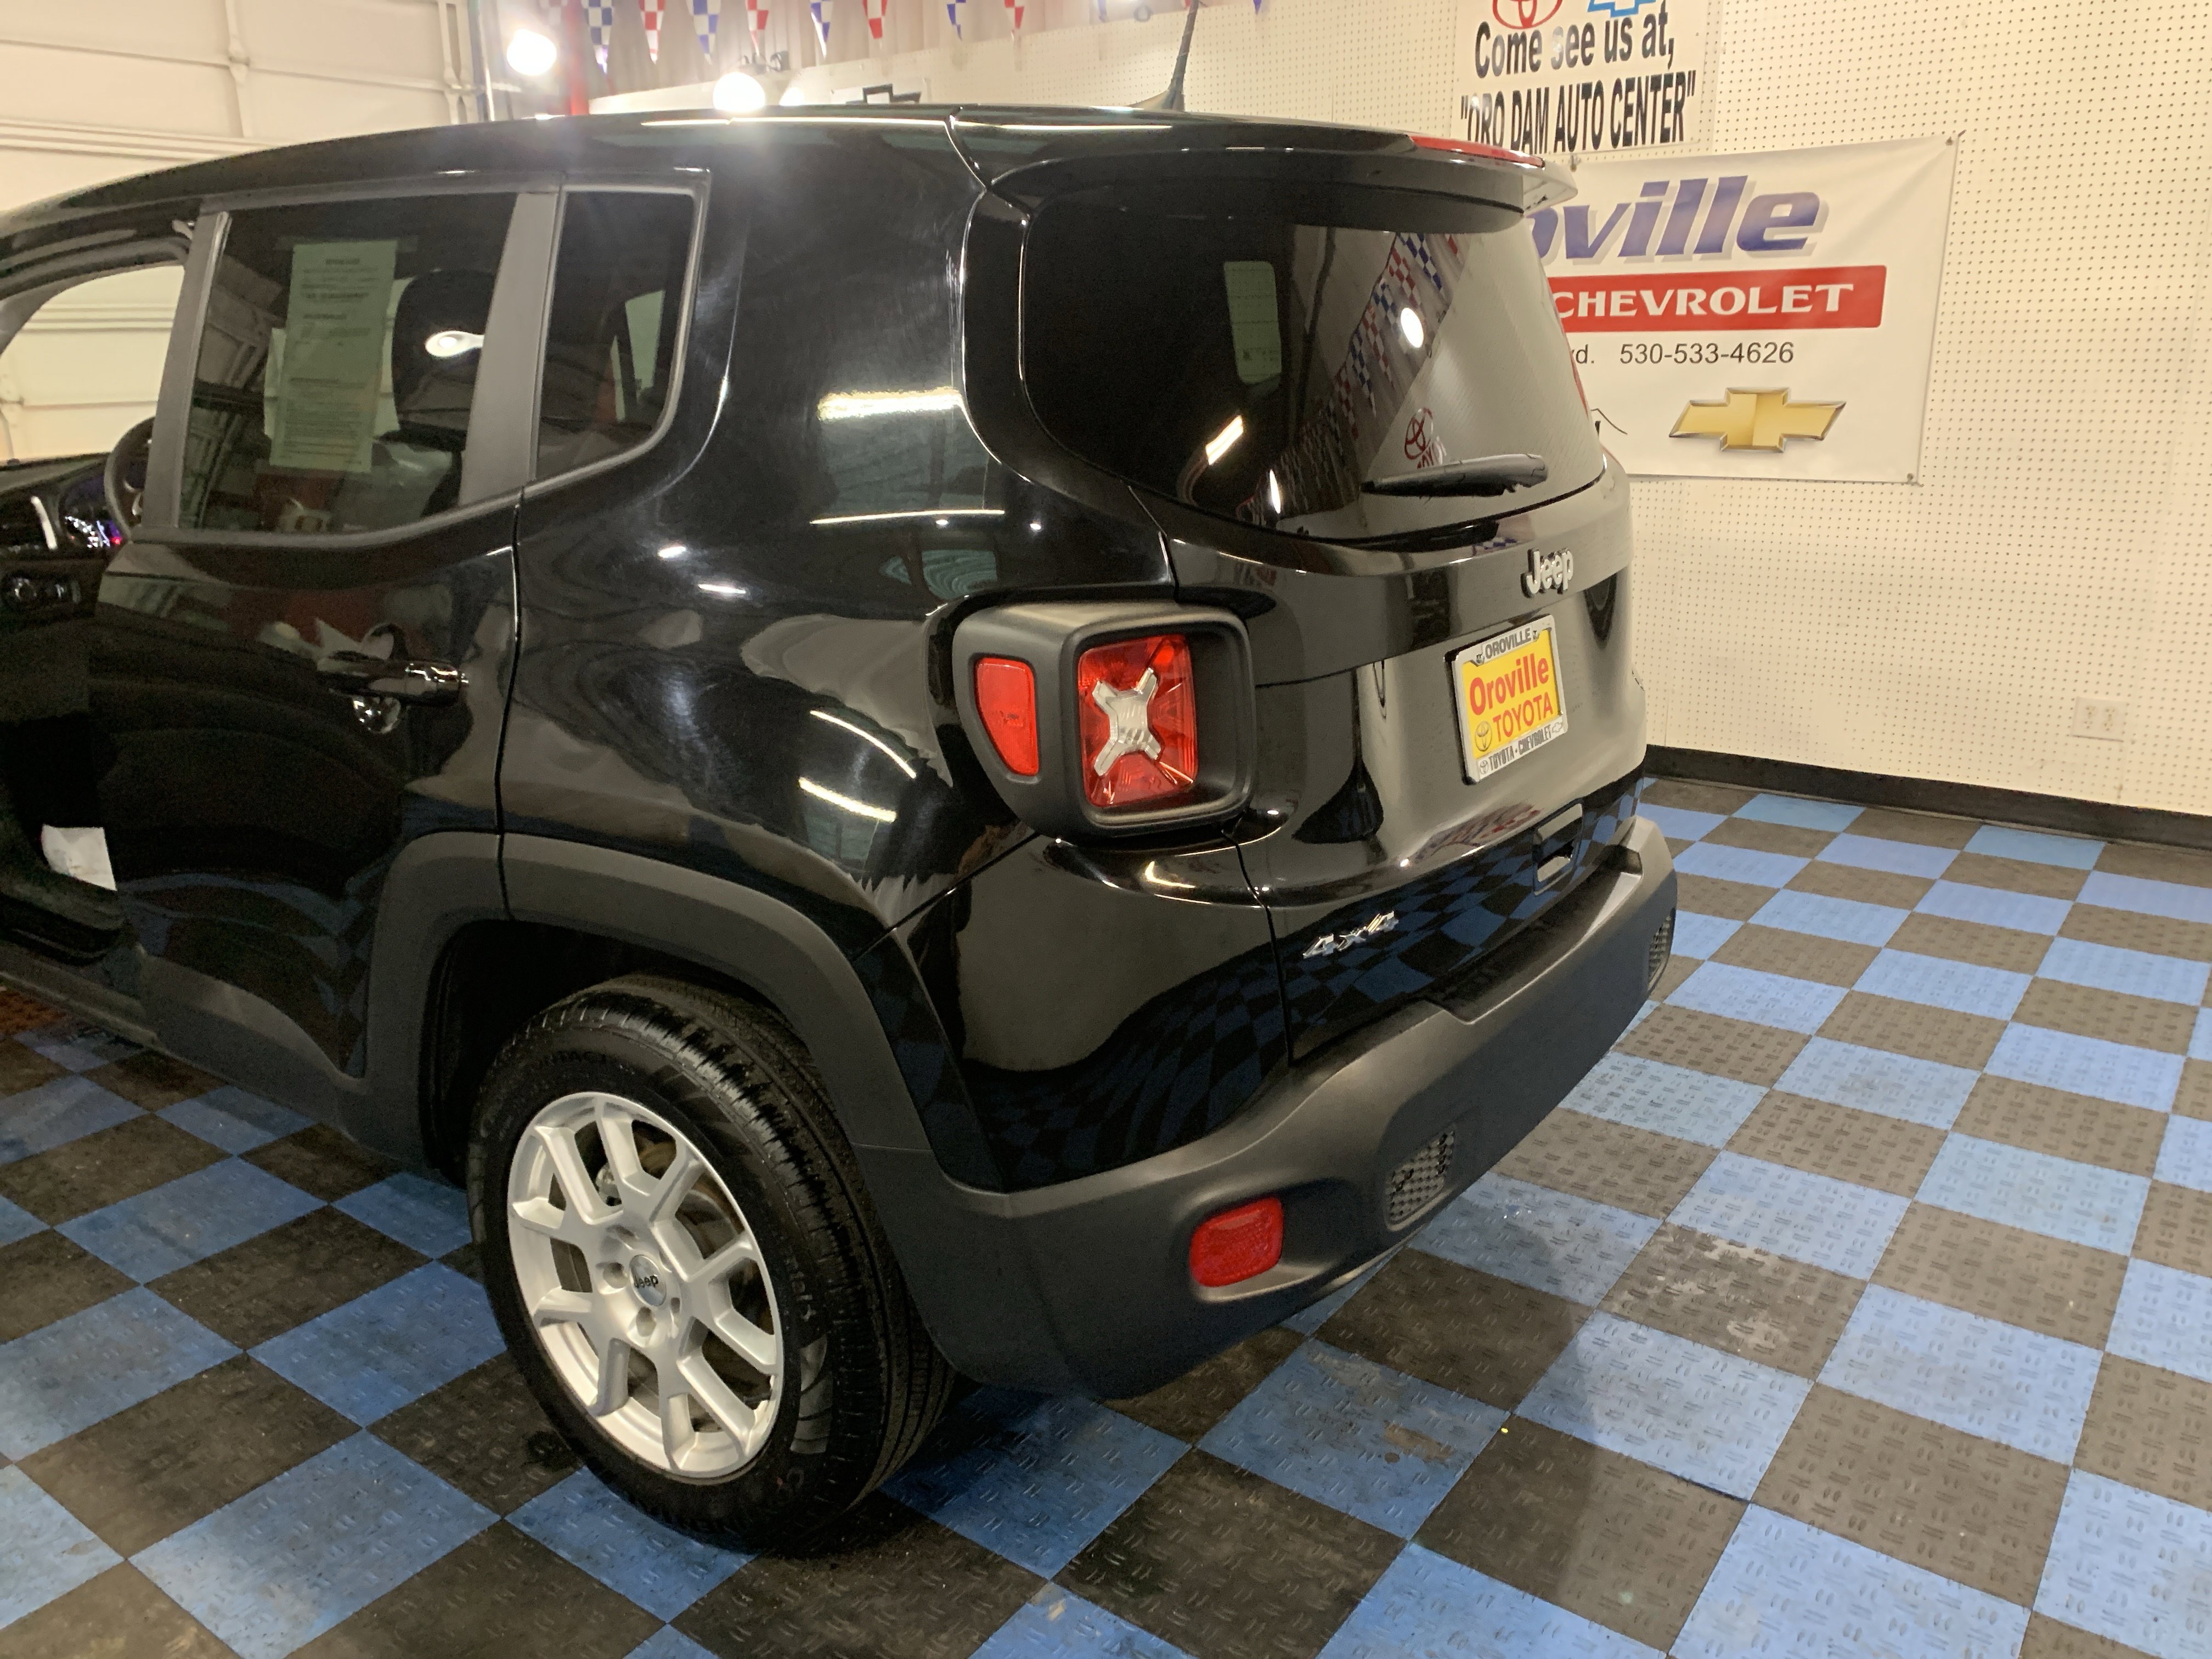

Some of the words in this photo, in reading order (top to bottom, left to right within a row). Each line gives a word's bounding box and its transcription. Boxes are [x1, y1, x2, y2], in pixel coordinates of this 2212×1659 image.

[1475, 21, 1543, 78] Come
[1550, 21, 1595, 70] see
[1604, 17, 1633, 63] us
[1641, 0, 1674, 70] at,
[1510, 86, 1550, 154] DAM
[1554, 80, 1604, 153] AUTO
[1610, 70, 1697, 149] CENTER"
[1552, 284, 1853, 319] CHEVROLET
[1620, 342, 1795, 365] 530-533-4626
[1521, 548, 1573, 597] Jeep
[1485, 628, 1531, 659] OROVILLE
[1470, 653, 1549, 716] Oroville
[1492, 691, 1553, 742] TOYOTA
[1488, 746, 1515, 771] TOYOTA
[1518, 724, 1551, 755] CHEVROLET
[634, 1274, 659, 1289] Jeep
